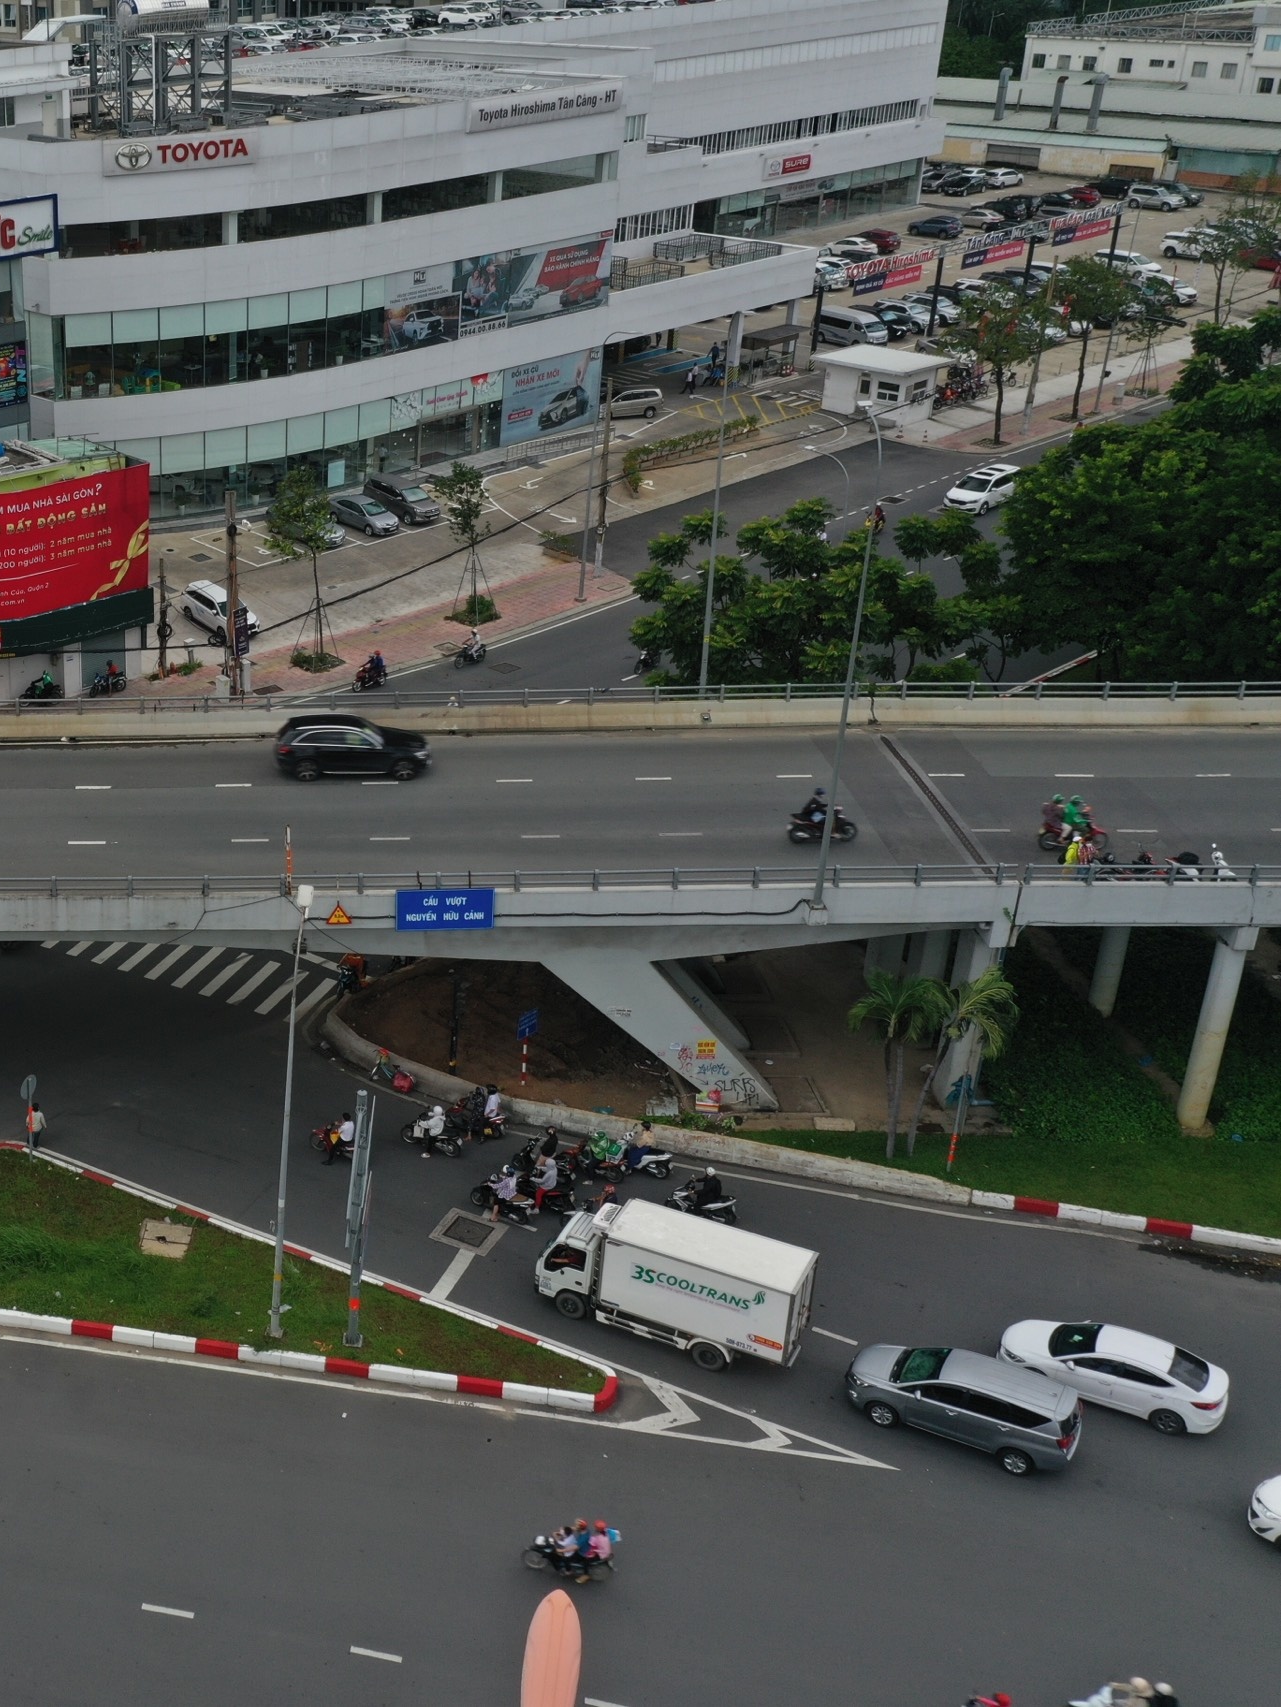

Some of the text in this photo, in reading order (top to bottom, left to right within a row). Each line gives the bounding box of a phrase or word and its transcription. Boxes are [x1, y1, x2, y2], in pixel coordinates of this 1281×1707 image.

[479, 108, 508, 123] Toyota
[511, 100, 556, 118] Hiroshima
[558, 96, 574, 110] Tân
[605, 90, 617, 104] HT
[157, 138, 249, 164] TOYOTA
[785, 158, 809, 168] SURE
[17, 223, 54, 247] Smile
[845, 248, 936, 280] TOYOTA Hiroshima
[460, 320, 506, 338] 0944.00.88.66
[515, 377, 535, 388] NHẬN
[536, 374, 545, 382] XE
[7, 503, 30, 514] MUA
[32, 496, 54, 509] NHÀ
[56, 492, 70, 505] SÀI
[6, 518, 33, 535] BẤT
[37, 510, 77, 530] ĐỘNG
[80, 502, 107, 518] SẢN
[4, 548, 16, 558] (10
[50, 540, 55, 548] 2
[57, 536, 75, 546] năm
[77, 532, 94, 541] mua
[97, 526, 112, 537] nhà
[57, 548, 75, 558] năm
[77, 544, 95, 554] mua
[97, 540, 112, 549] nhà
[445, 896, 467, 907] VƯỢT
[464, 910, 484, 920] CẢNH
